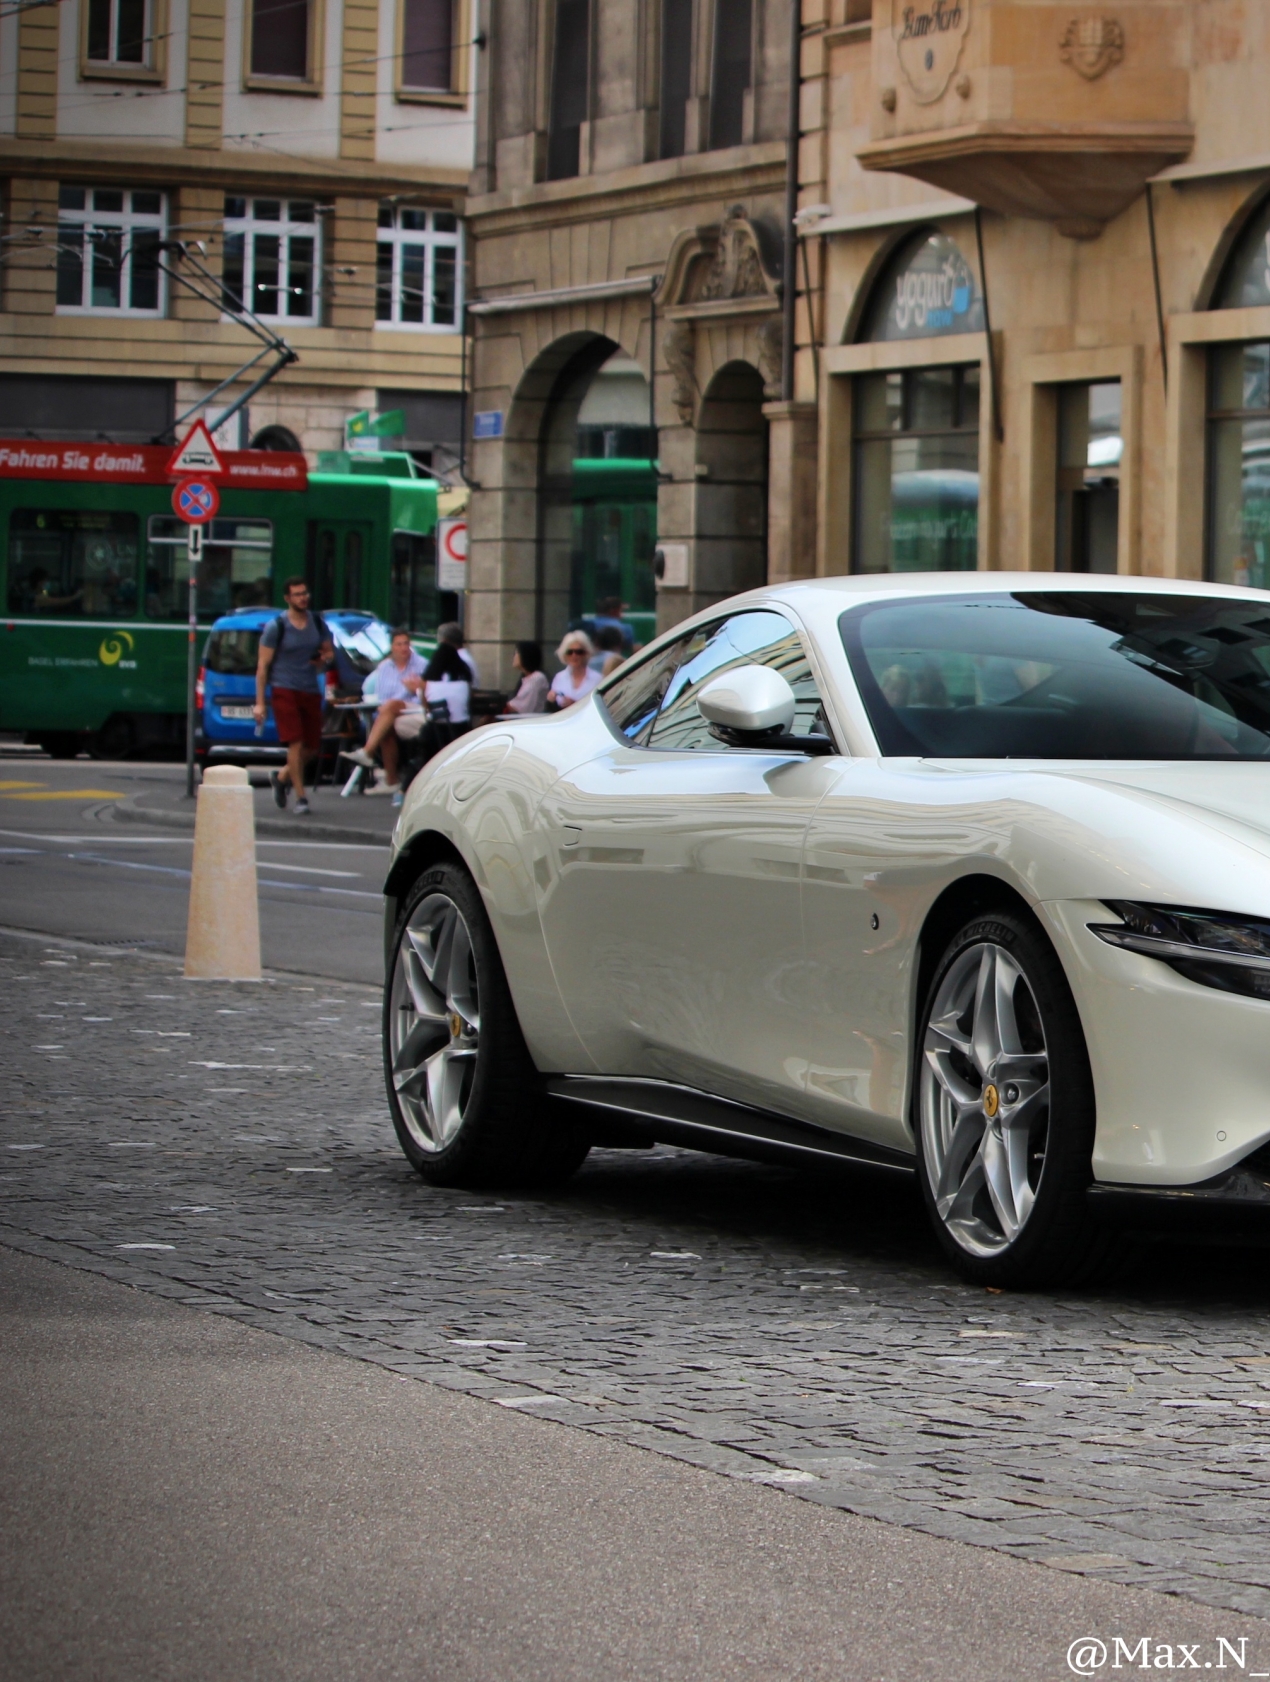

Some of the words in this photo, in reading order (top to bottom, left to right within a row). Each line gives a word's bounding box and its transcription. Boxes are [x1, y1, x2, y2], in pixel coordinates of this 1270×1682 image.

[895, 254, 954, 331] yogurt
[0, 448, 59, 469] Fahren
[62, 451, 90, 470] Sie
[966, 921, 1015, 942] MICHELIN
